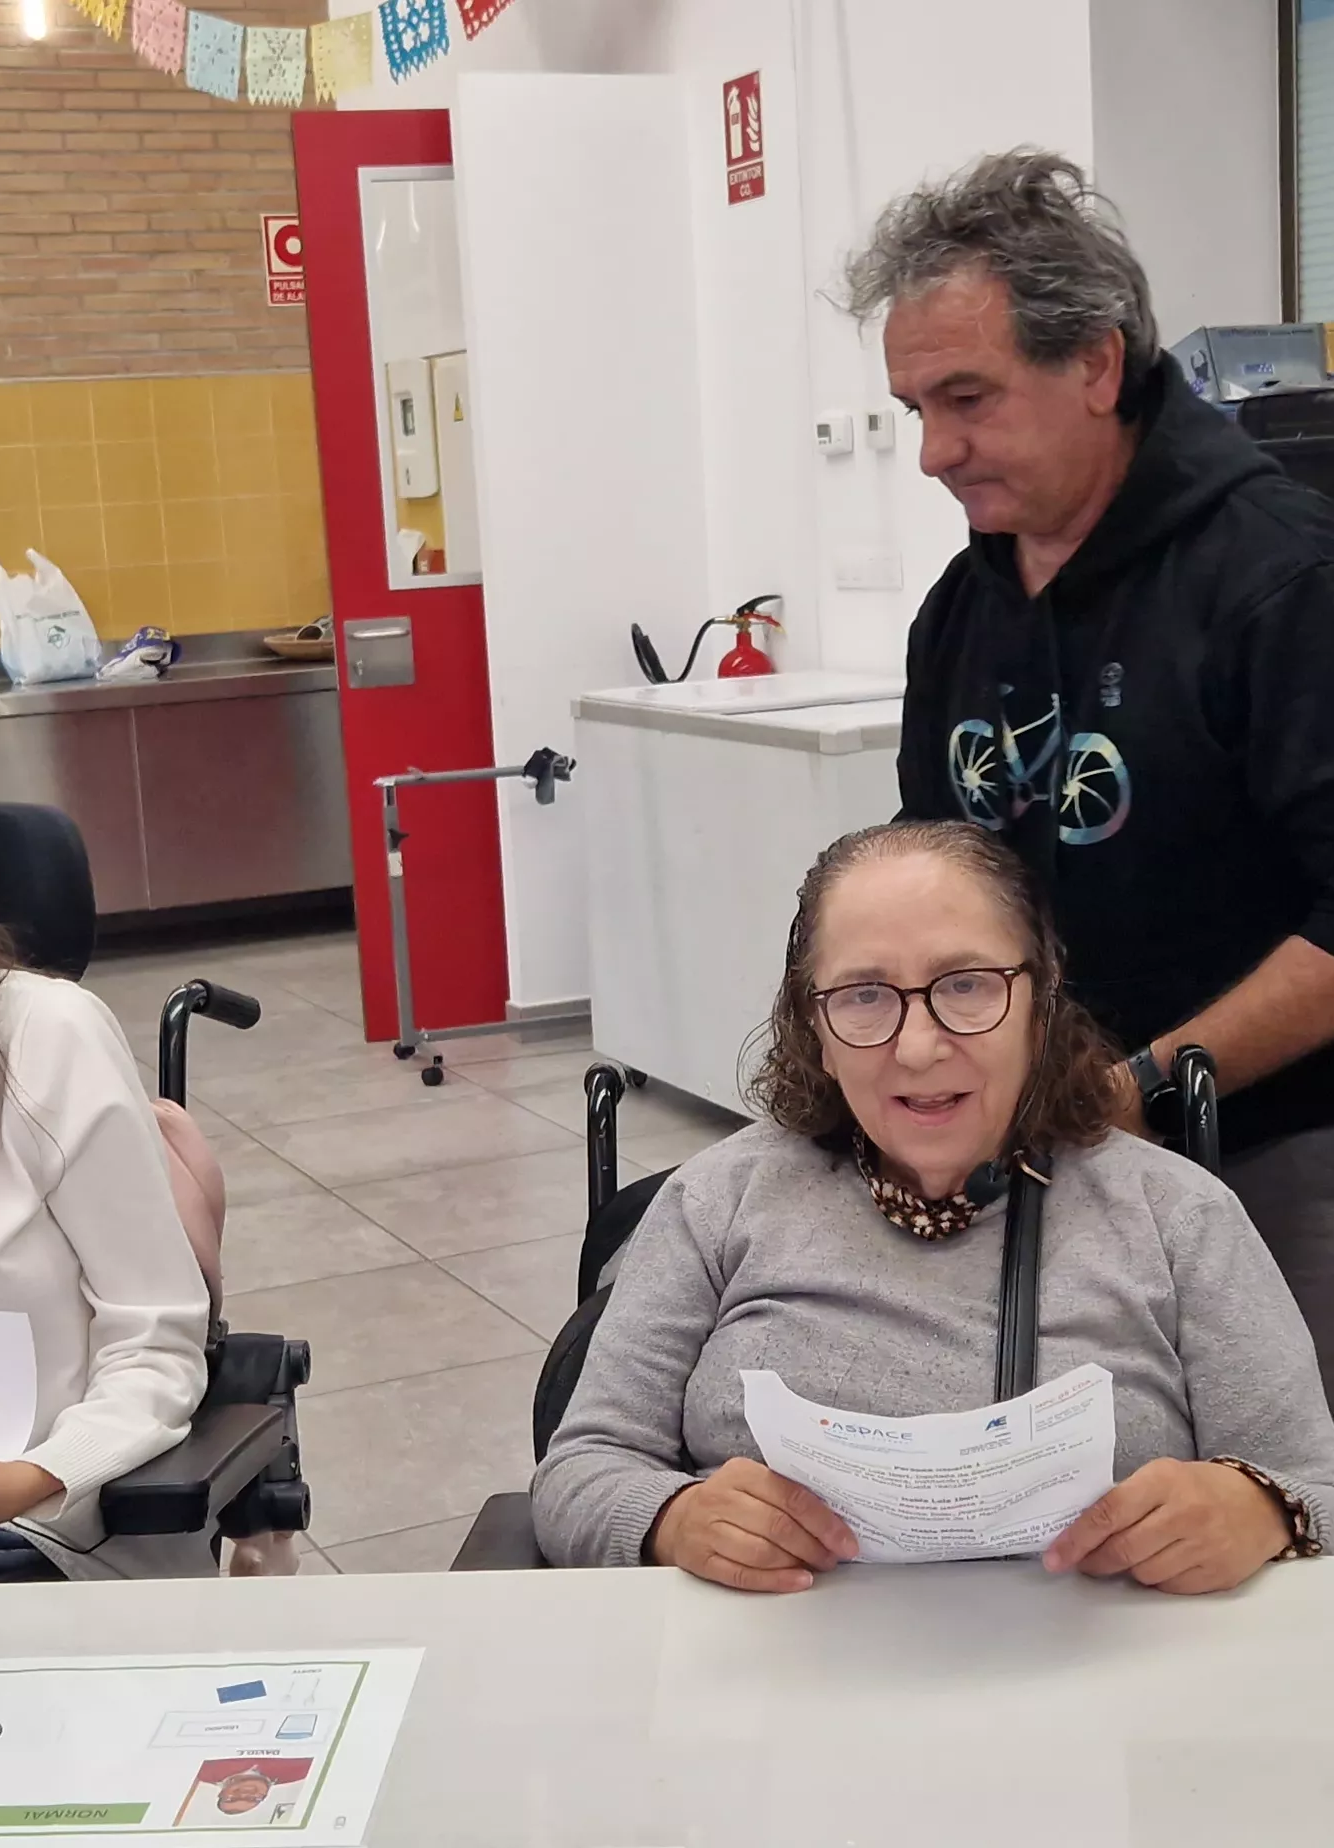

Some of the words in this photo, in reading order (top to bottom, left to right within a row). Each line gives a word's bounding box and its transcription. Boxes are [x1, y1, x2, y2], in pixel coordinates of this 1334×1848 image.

[729, 165, 762, 185] EXTINTOR
[272, 292, 285, 302] DE
[286, 291, 305, 302] ALA
[831, 1422, 914, 1441] ASPACE
[22, 1808, 109, 1821] NORMAL
